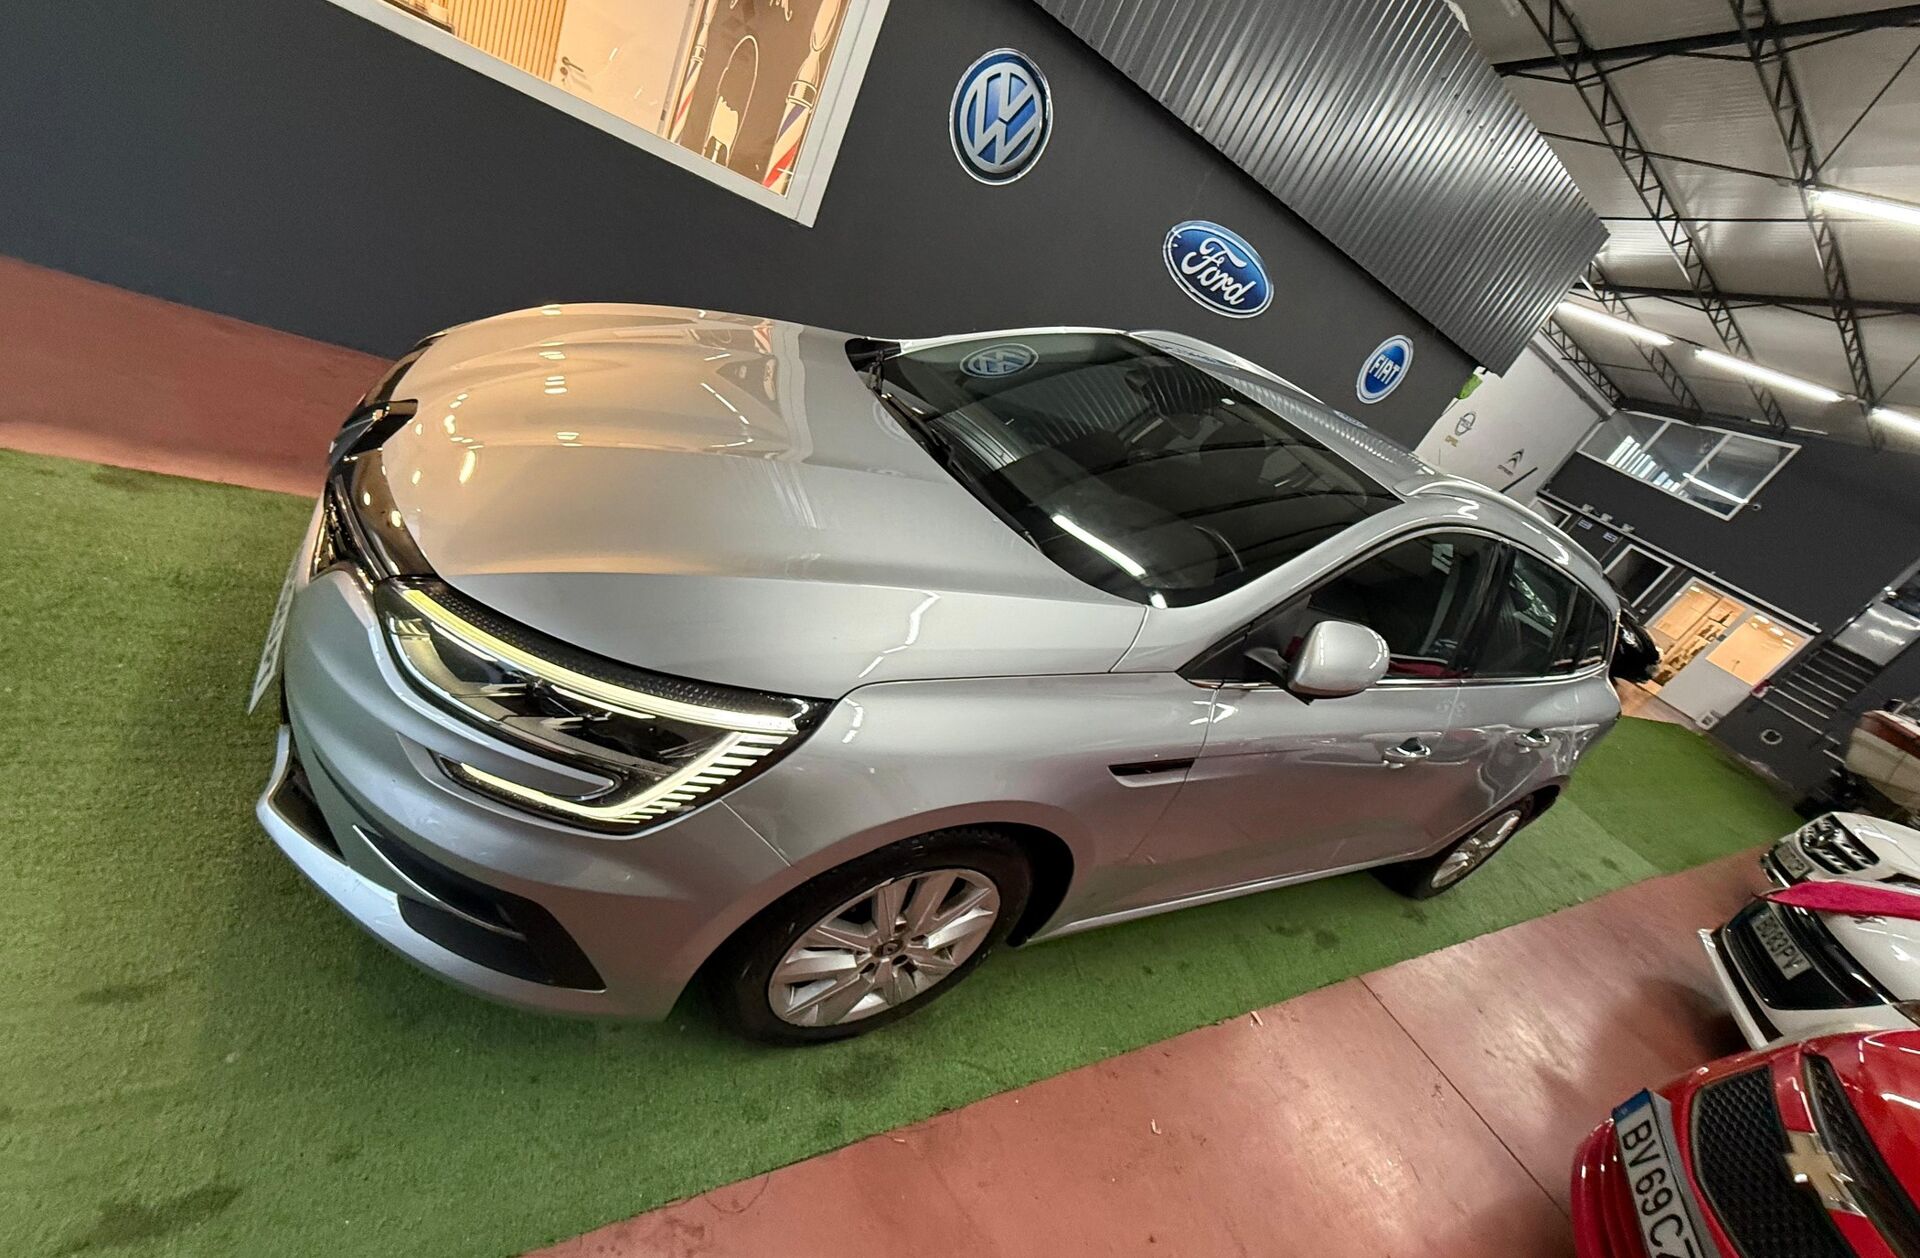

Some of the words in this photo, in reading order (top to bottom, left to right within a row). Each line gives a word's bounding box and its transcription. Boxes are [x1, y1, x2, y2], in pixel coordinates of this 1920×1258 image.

[959, 61, 1043, 174] VW
[1181, 237, 1256, 305] Ford
[1369, 354, 1401, 385] FIAT
